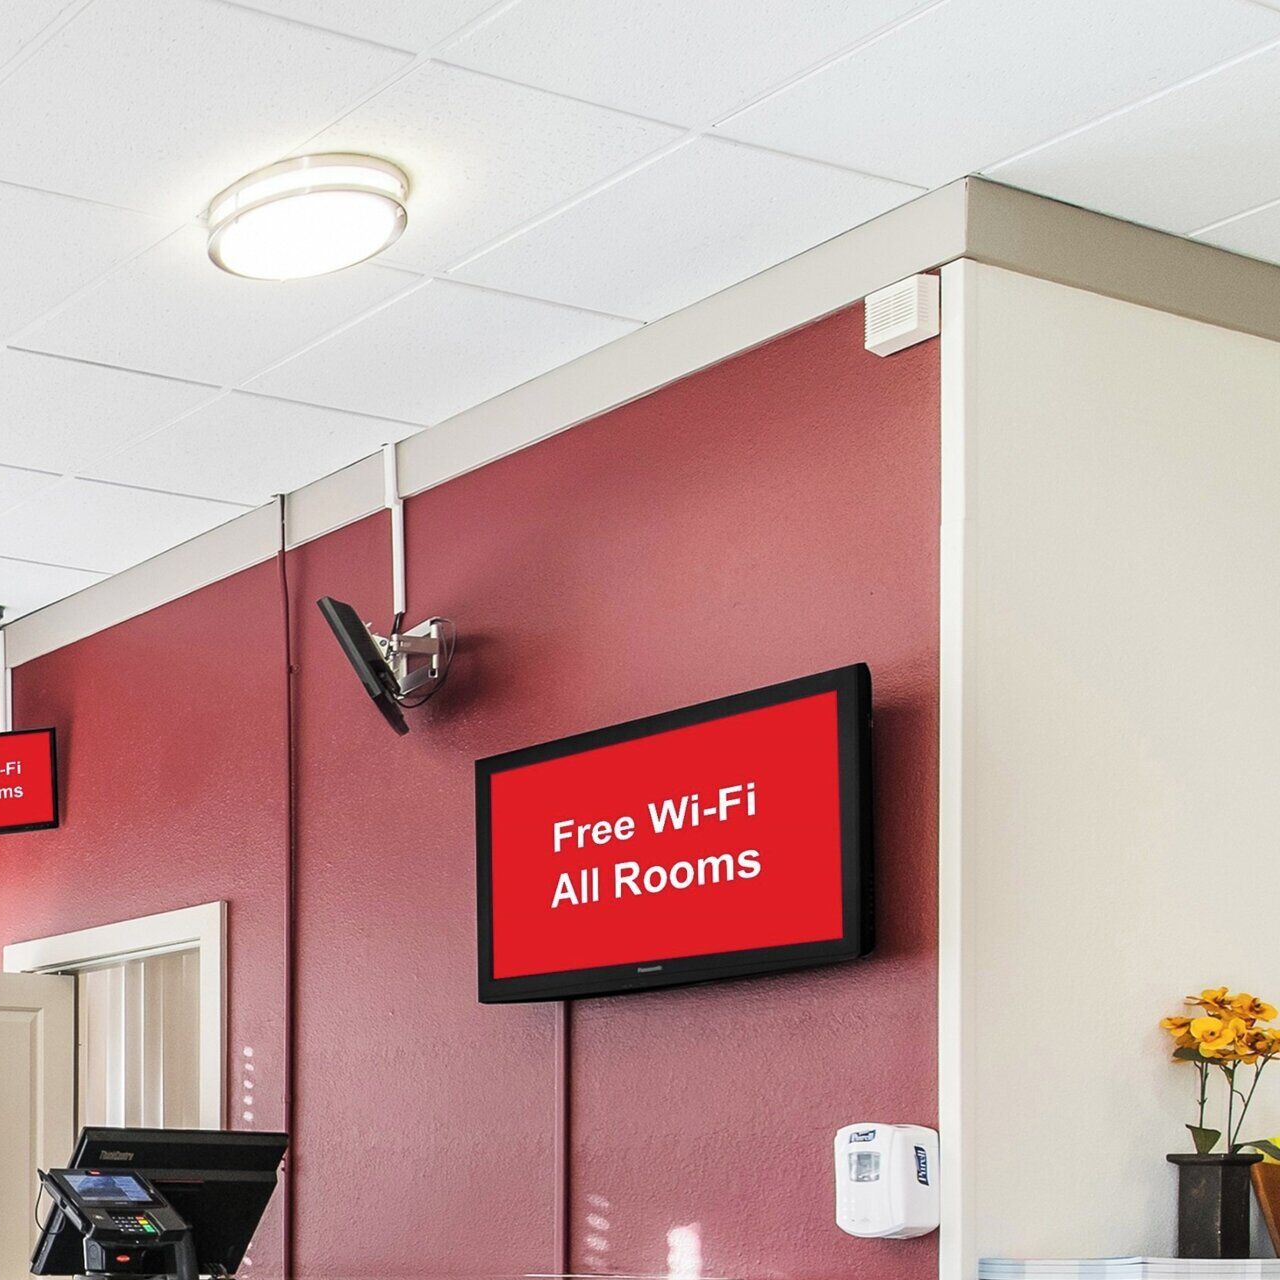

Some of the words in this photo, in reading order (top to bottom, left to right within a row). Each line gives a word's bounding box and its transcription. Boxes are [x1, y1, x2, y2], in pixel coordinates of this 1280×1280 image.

[553, 816, 635, 853] Free
[647, 782, 756, 834] Wi-Fi
[551, 867, 599, 909] All
[614, 849, 761, 899] Rooms
